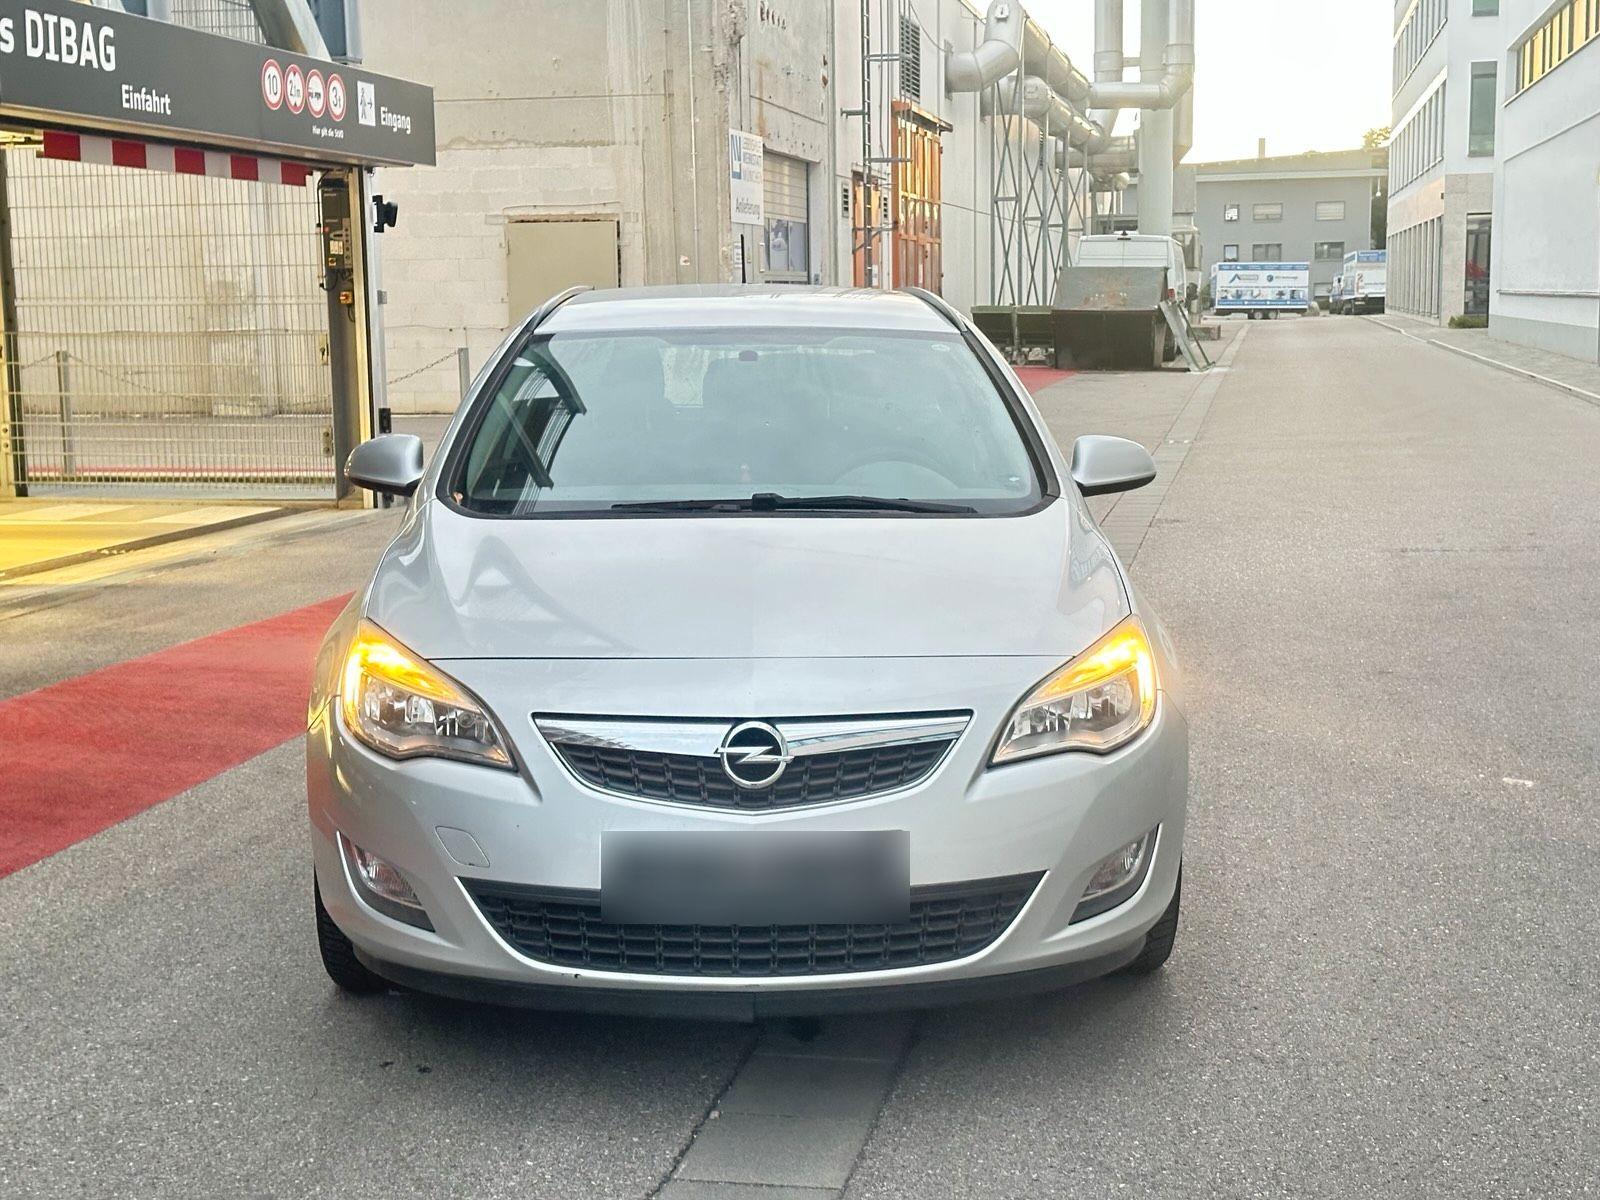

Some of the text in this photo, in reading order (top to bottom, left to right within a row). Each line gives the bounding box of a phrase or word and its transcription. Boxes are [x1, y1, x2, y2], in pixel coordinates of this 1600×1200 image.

[25, 9, 116, 72] DIBAG
[121, 83, 172, 115] Einfahrt
[267, 74, 278, 96] 10
[380, 106, 411, 135] Eingang
